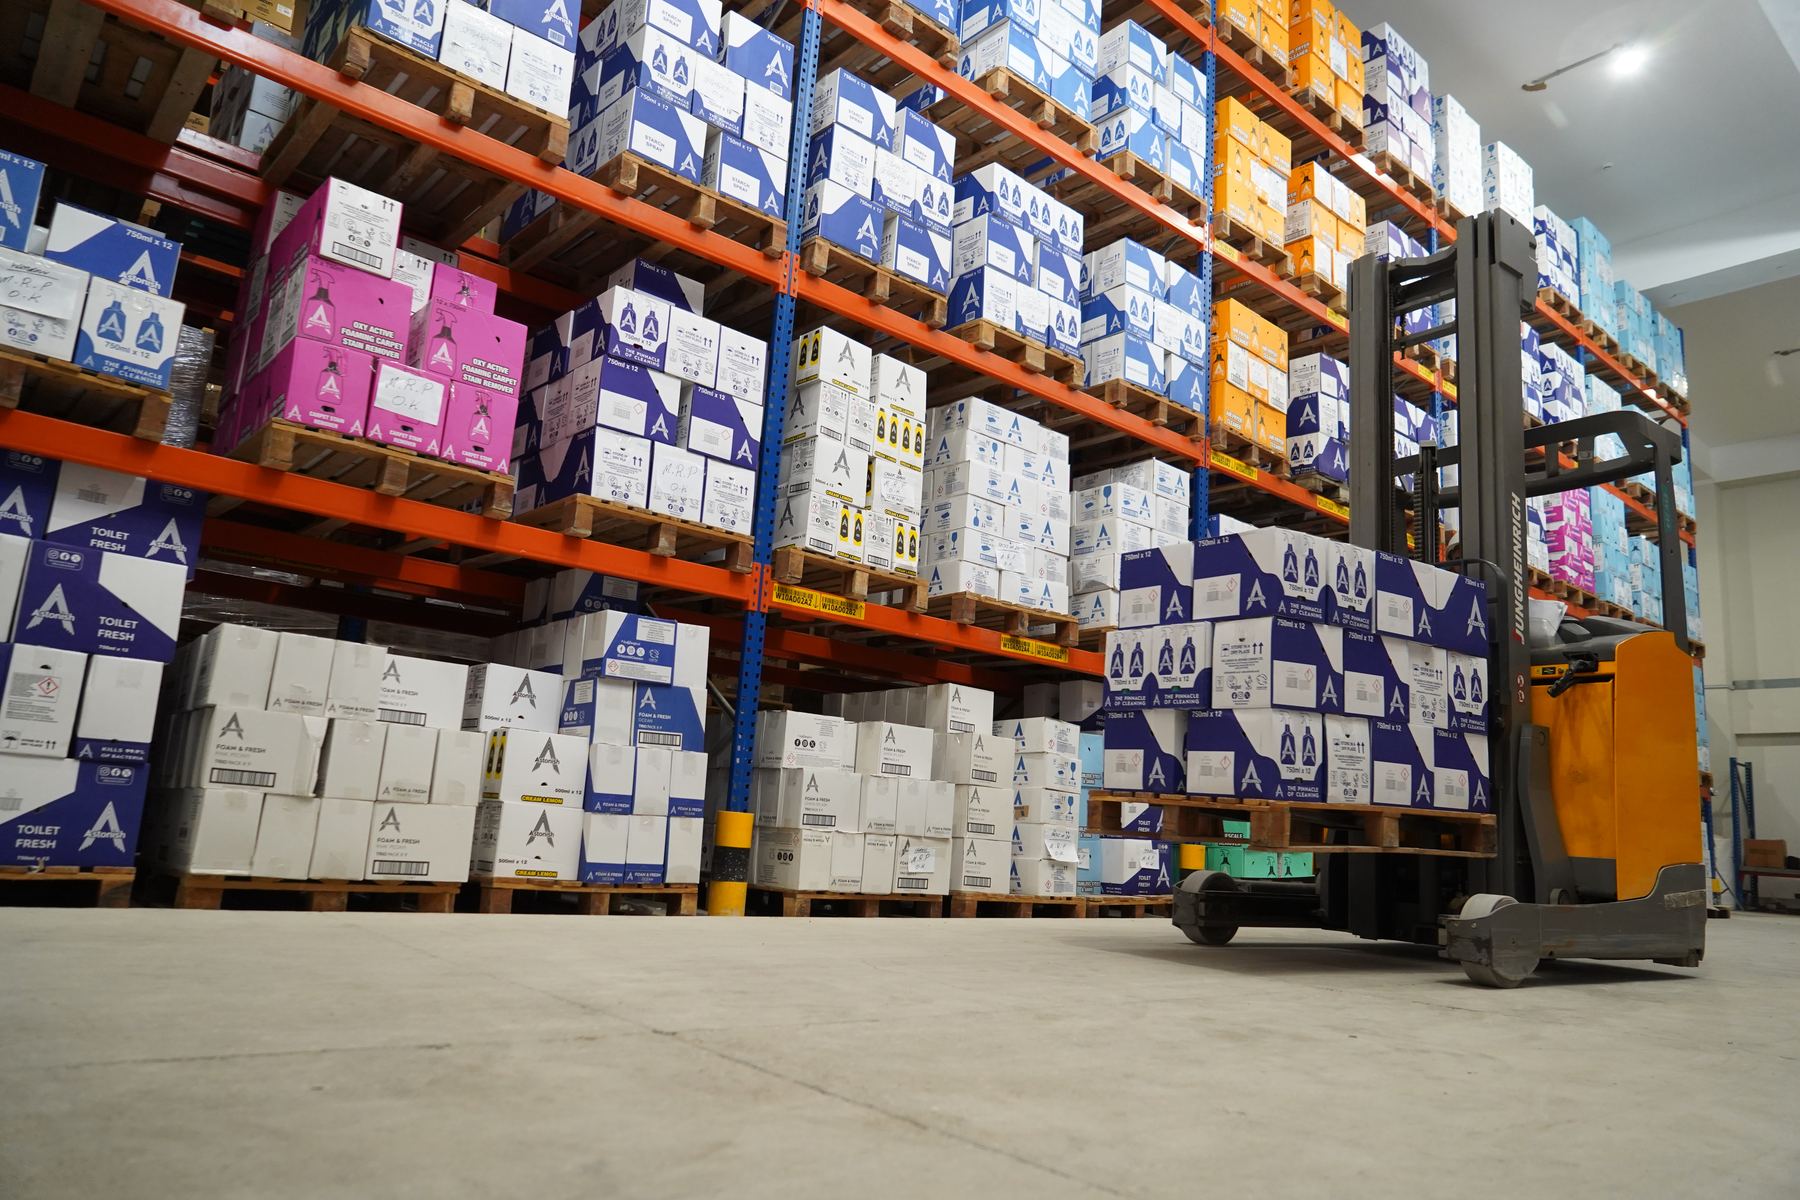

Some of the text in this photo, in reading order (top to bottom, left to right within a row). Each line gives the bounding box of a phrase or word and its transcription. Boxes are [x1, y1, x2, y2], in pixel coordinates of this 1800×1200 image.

[767, 34, 781, 45] 750ml
[640, 92, 658, 106] 750ml
[662, 103, 669, 111] 12
[644, 134, 666, 149] STARCH
[126, 228, 153, 243] 750ml
[162, 241, 173, 250] 12
[640, 260, 655, 272] 750ml
[353, 321, 395, 338] OXY ACTIVE
[341, 327, 404, 351] FOAMING CARPET
[342, 338, 400, 359] STAIN REMOVER
[634, 355, 660, 367] CLEANING
[636, 351, 660, 362] PINNACLE
[104, 360, 163, 381] THE PINNACLE
[472, 358, 509, 374] OXY ACTIVE
[607, 358, 626, 370] 750ml
[631, 365, 639, 373] 12
[103, 366, 163, 386] OF CLEANING
[462, 364, 517, 385] FOAMING CARPET
[463, 373, 514, 394] STAIN REMOVER
[698, 386, 713, 398] 750ml
[717, 393, 726, 401] 12
[91, 526, 130, 541] TOILET
[89, 539, 127, 552] FRESH
[149, 539, 188, 552] Astonish
[1124, 553, 1139, 561] 750ml
[1379, 552, 1393, 563] 750ml
[1397, 556, 1404, 565] 12
[1512, 492, 1525, 645] JUNGHEINRICH
[1289, 584, 1303, 592] 750ml
[31, 609, 76, 622] Astonish
[1299, 610, 1323, 619] CLEANING
[1300, 605, 1322, 614] PINNACLE
[99, 616, 138, 629] TOILET
[1277, 620, 1293, 628] 750ml
[1298, 622, 1306, 630] 12
[1350, 621, 1369, 629] CLEANING
[1351, 616, 1370, 625] PINNACLE
[97, 629, 135, 642] FRESH
[1348, 631, 1362, 640] 750ml
[1367, 634, 1374, 642] 12
[512, 691, 537, 700] Astonish
[1377, 722, 1390, 730] 750ml
[1395, 723, 1402, 731] 12
[1469, 719, 1486, 727] PINNACLE
[101, 746, 123, 754] KILLS
[110, 753, 144, 761] BACTERIA
[535, 757, 560, 765] Astonish
[1138, 819, 1151, 827] TOILET
[17, 825, 61, 836] TOILET
[83, 829, 126, 839] Astonish
[15, 839, 57, 849] FRESH
